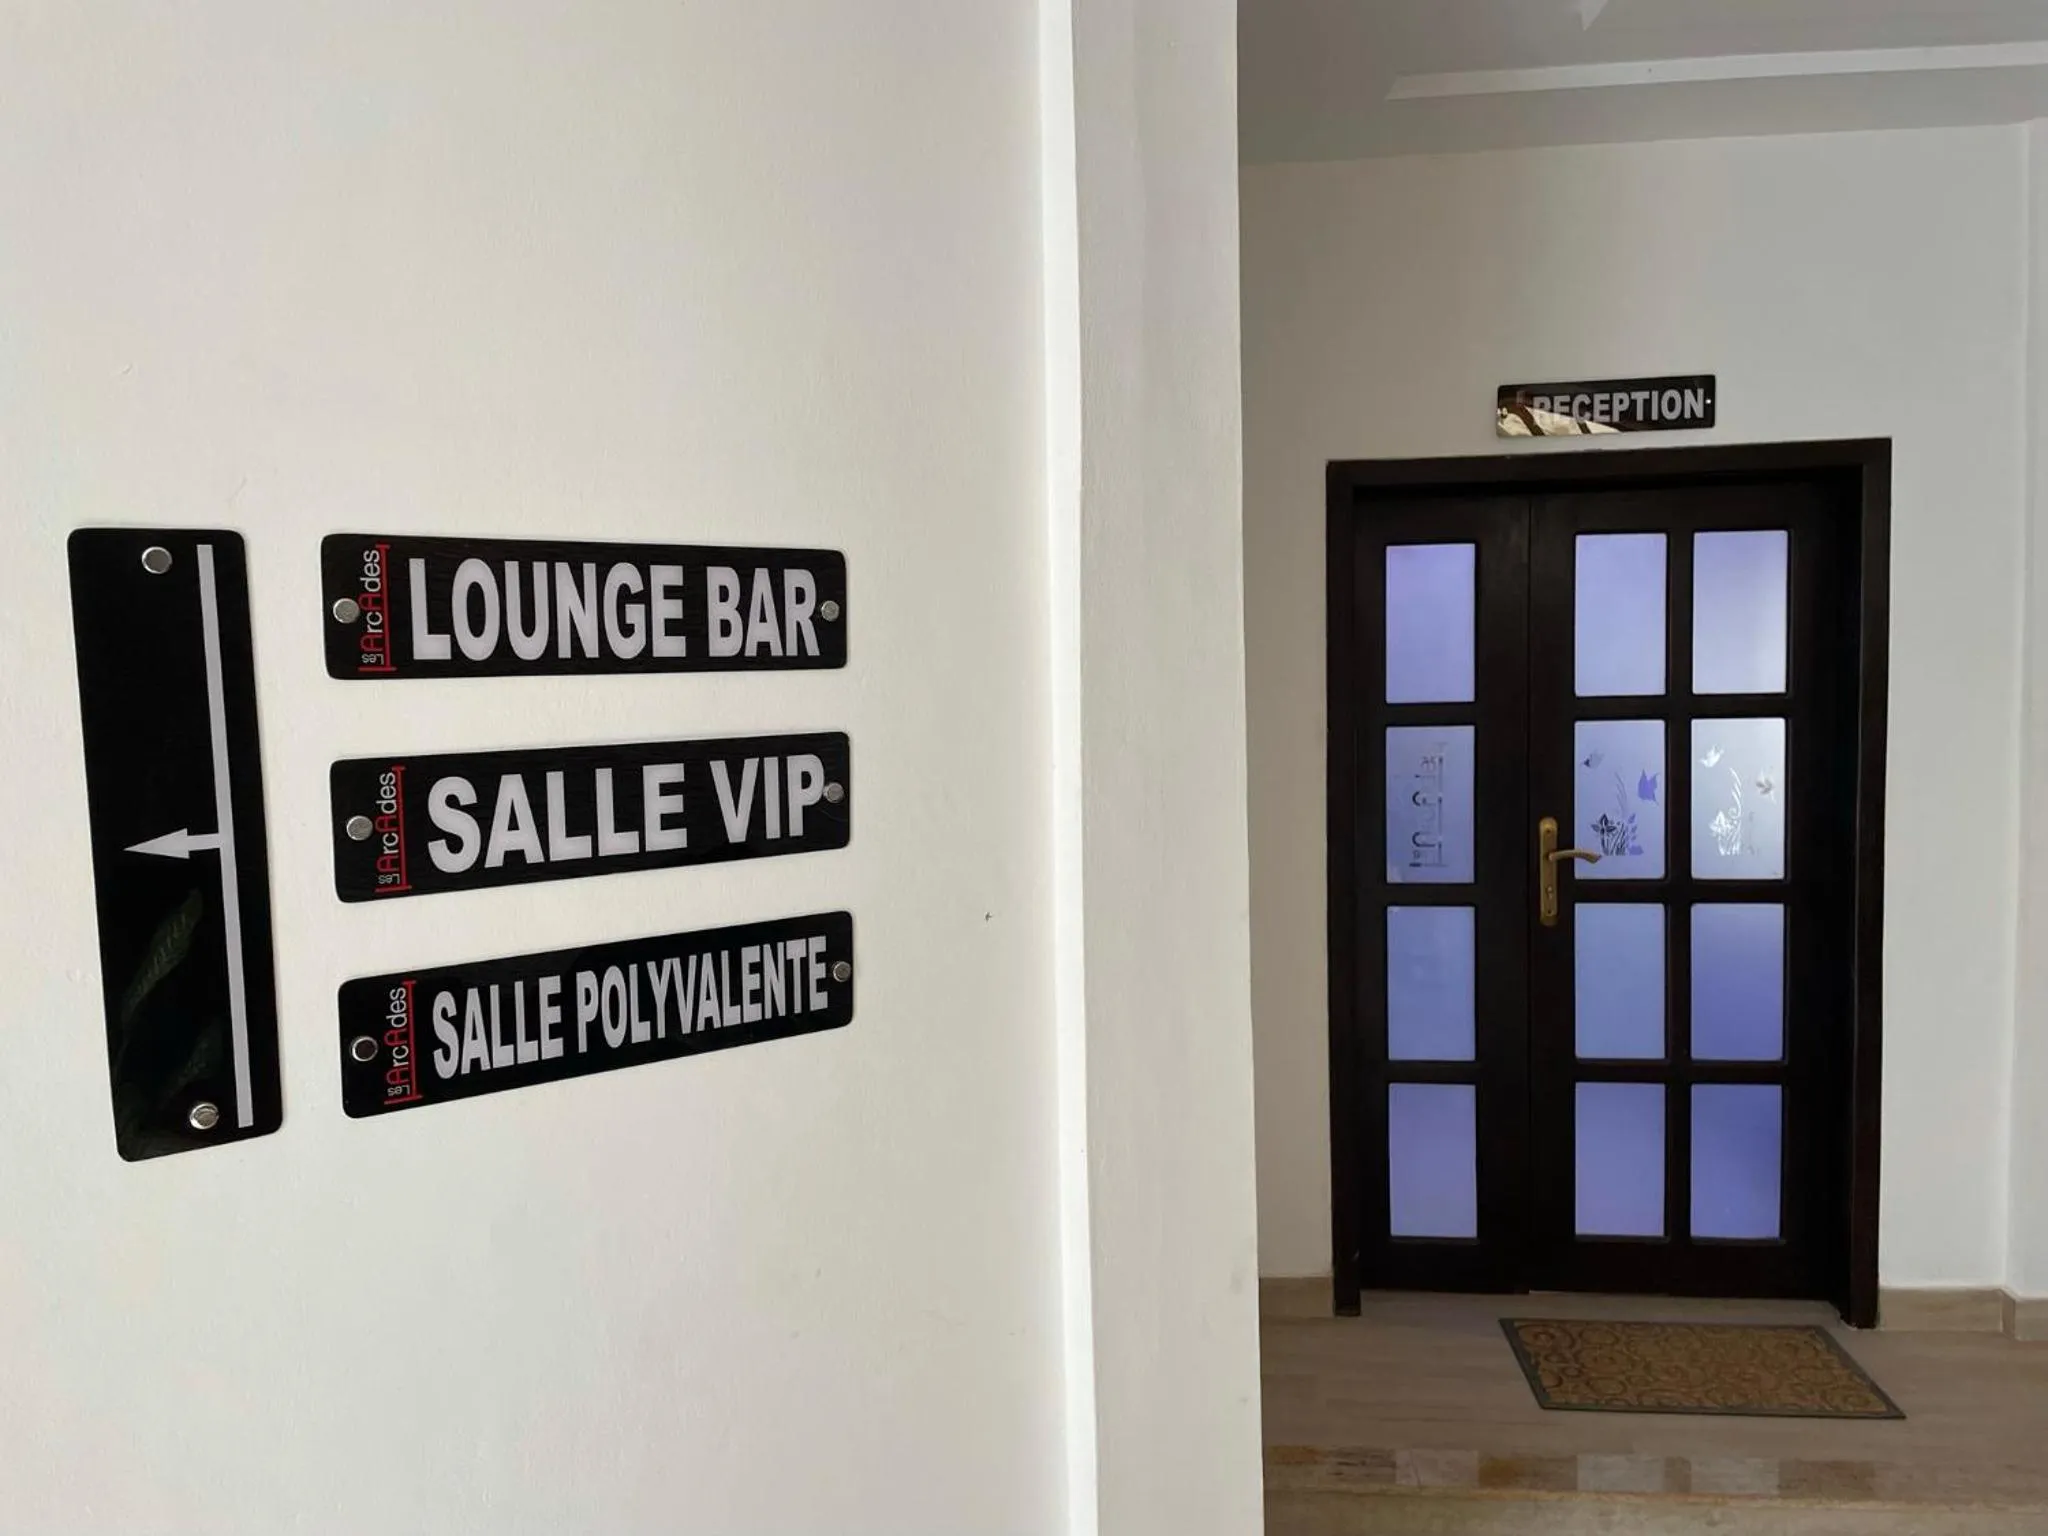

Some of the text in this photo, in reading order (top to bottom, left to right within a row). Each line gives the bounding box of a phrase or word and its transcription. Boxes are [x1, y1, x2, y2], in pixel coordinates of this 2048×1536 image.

[358, 549, 384, 652] ArcAdes
[408, 557, 821, 662] LOUNGE BAR
[375, 772, 400, 872] ArcAdes
[427, 753, 825, 874] SALLE VIP
[384, 987, 410, 1085] ArcAdes
[432, 935, 829, 1080] SALLE POLYVALENTE
